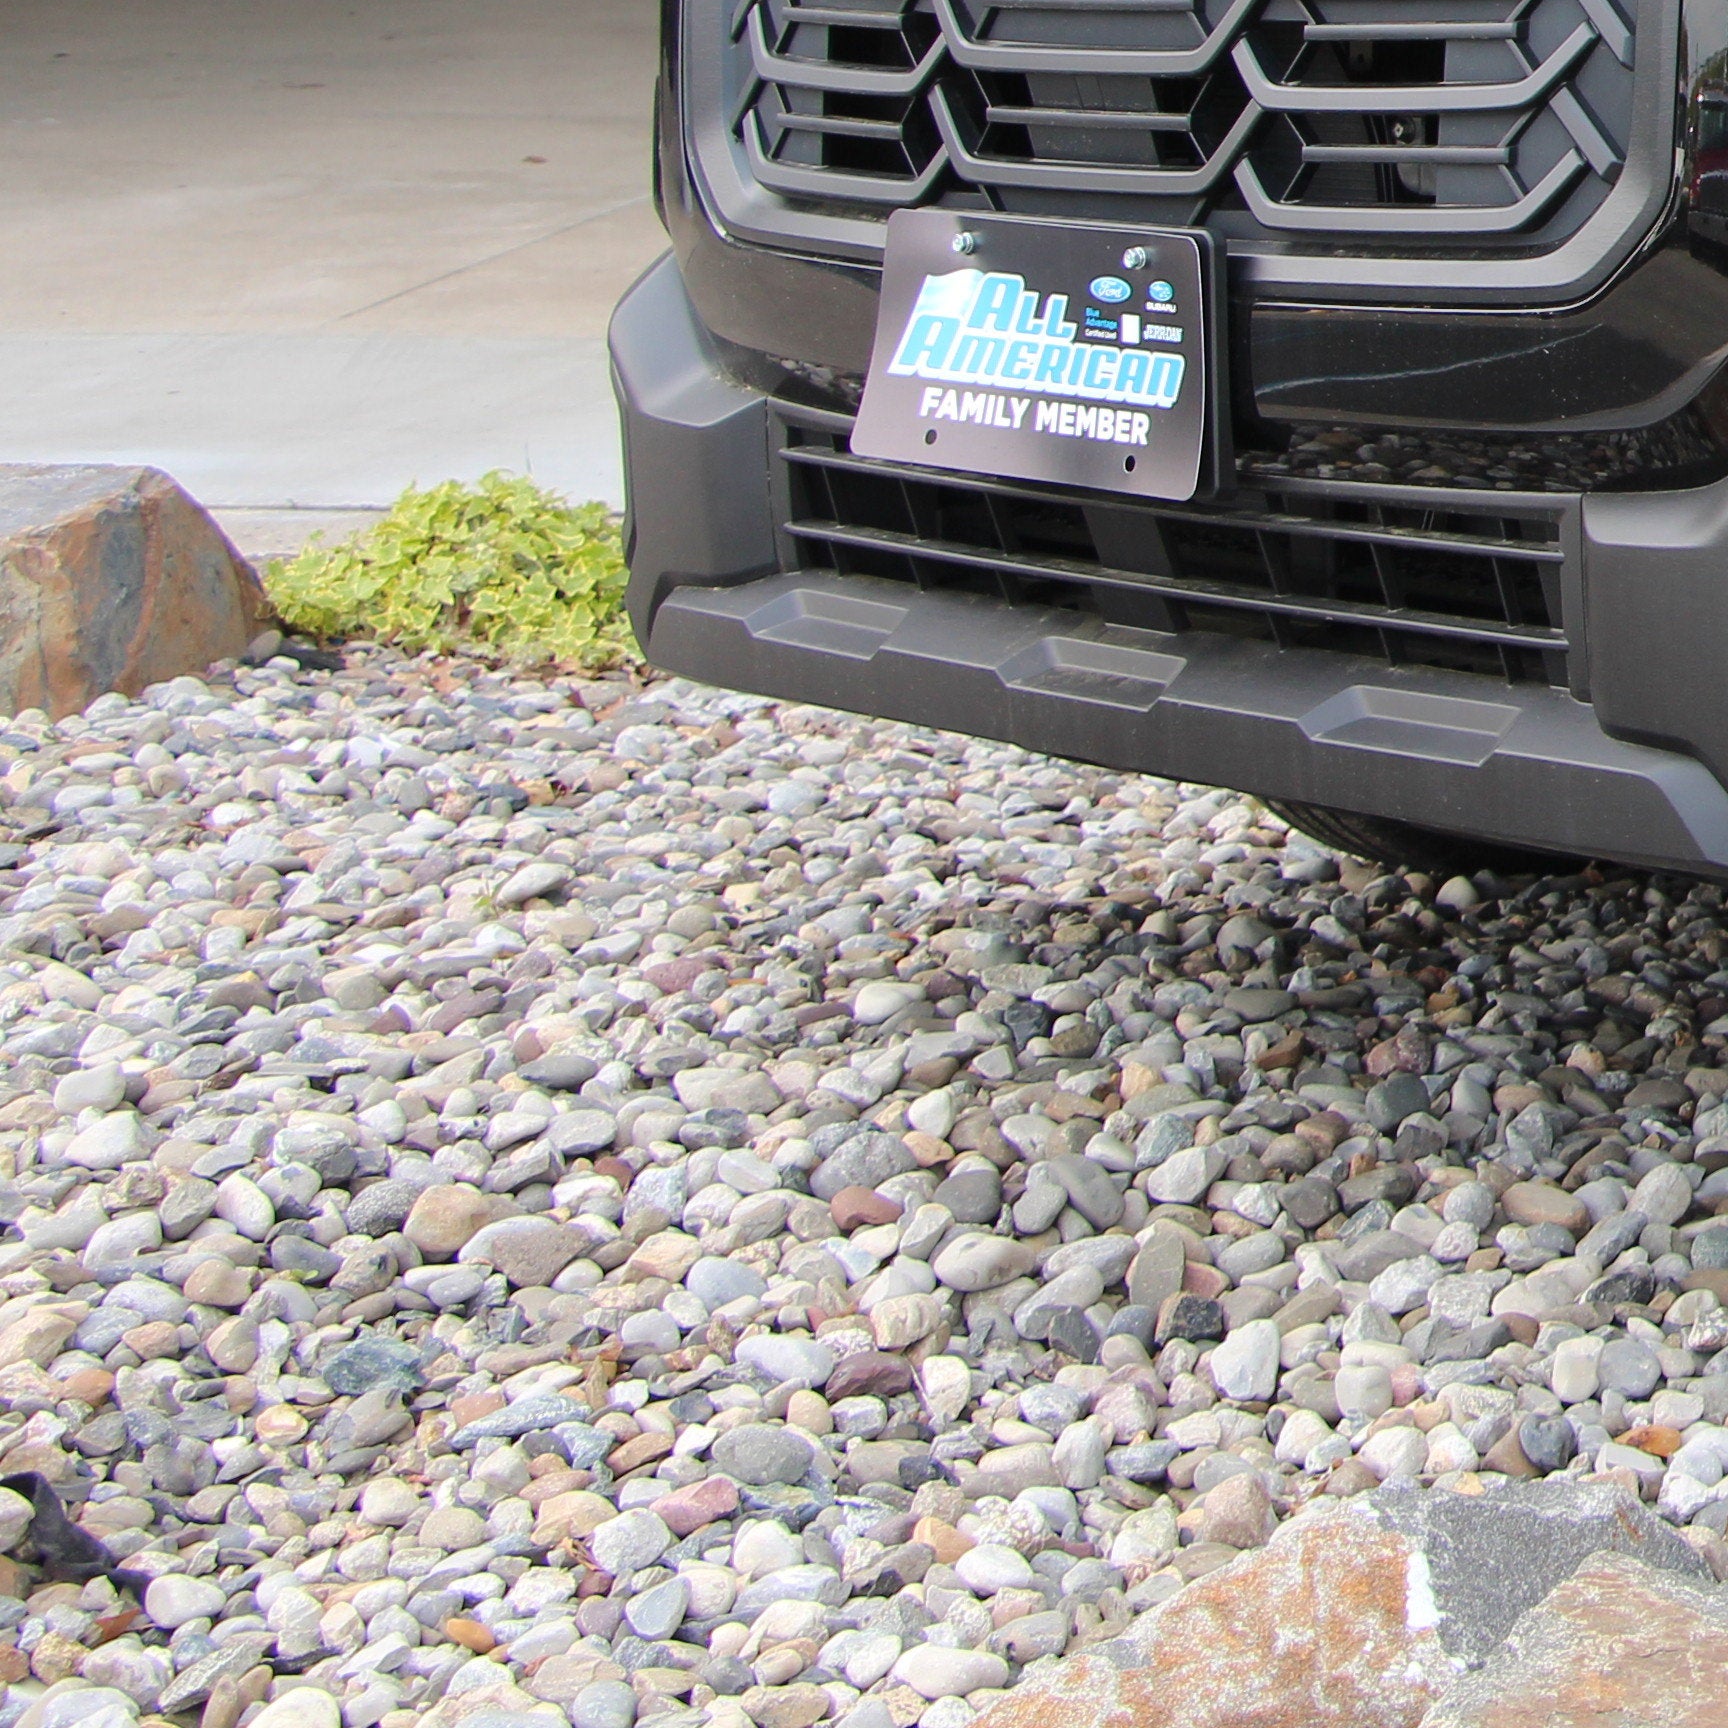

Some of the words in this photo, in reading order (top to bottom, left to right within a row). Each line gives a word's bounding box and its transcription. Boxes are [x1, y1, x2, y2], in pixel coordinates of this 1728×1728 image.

[966, 273, 1077, 341] ALL
[1145, 301, 1177, 313] SUBARU
[889, 314, 1185, 405] AMERICAN
[919, 386, 1031, 430] FAMILY
[1034, 400, 1150, 446] MEMBER
